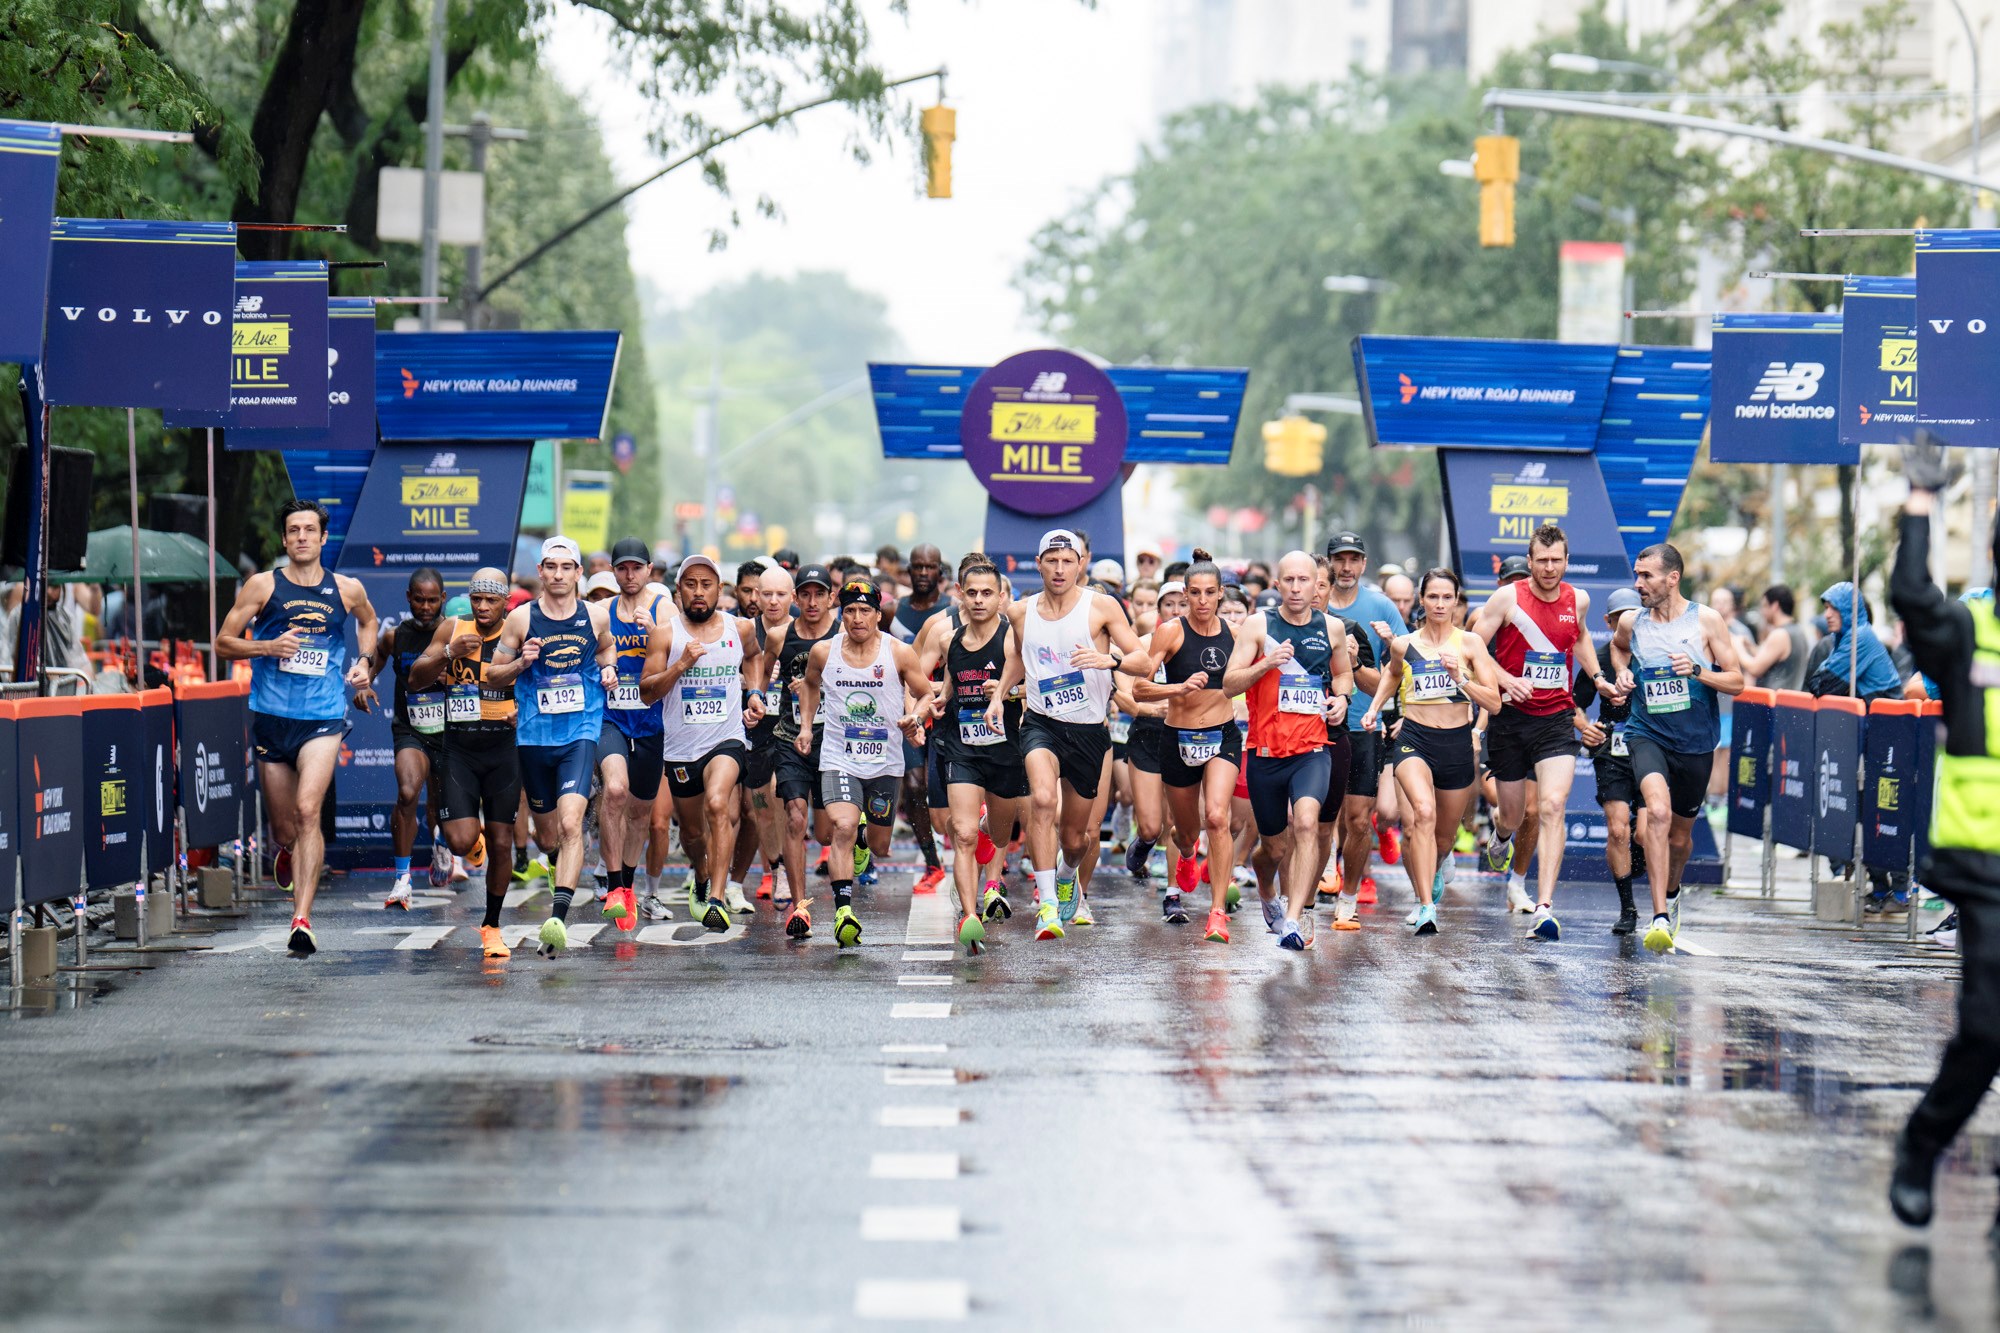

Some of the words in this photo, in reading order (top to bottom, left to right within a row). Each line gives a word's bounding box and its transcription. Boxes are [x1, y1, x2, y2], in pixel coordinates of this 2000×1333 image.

[60, 306, 222, 325] VOLVO
[236, 358, 279, 380] ILE
[423, 380, 452, 392] NEW
[453, 379, 486, 392] YORK
[487, 379, 521, 391] ROAD
[522, 379, 578, 391] RUNNERS
[239, 397, 261, 405] ROAD
[261, 397, 298, 405] RUNNERS
[1420, 386, 1450, 399] NEW
[1451, 387, 1484, 400] YORK
[1484, 388, 1519, 401] ROAD
[1519, 389, 1576, 403] RUNNERS
[1735, 404, 1768, 418] new
[1769, 402, 1836, 419] balance
[1873, 413, 1894, 422] NEW
[1893, 414, 1917, 422] YORK
[1003, 412, 1043, 433] 5th
[1002, 443, 1083, 473] MILE
[411, 483, 440, 500] 5th
[411, 507, 470, 528] MILE
[386, 553, 405, 562] NEW
[405, 553, 424, 562] YORK
[424, 553, 444, 562] ROAD
[445, 553, 479, 562] RUNNERS
[283, 600, 306, 610] DASHING
[306, 600, 334, 614] WHIPPETS
[1559, 614, 1576, 624] PPTC
[311, 626, 328, 634] TEAM
[562, 634, 588, 645] WHIPPETS
[295, 649, 323, 666] 3992
[545, 659, 568, 669] RUNNING
[568, 658, 581, 666] TEAM
[682, 665, 737, 678] EBELDES
[957, 669, 991, 682] URBAN
[1524, 666, 1532, 677] A
[1536, 666, 1561, 680] 2178
[678, 678, 714, 686] RUNNING
[835, 680, 884, 688] ORLANDO
[1414, 680, 1422, 692] A
[1425, 674, 1452, 689] 2102
[1647, 684, 1654, 697] A
[1656, 680, 1684, 696] 2168
[541, 693, 549, 706] A
[554, 689, 576, 704] 192
[609, 690, 617, 702] A
[620, 687, 639, 700] 210
[1045, 696, 1054, 708] A
[1055, 687, 1084, 705] 3958
[1281, 690, 1290, 701] A
[1293, 690, 1318, 704] 4092
[410, 707, 417, 719] A
[418, 705, 443, 719] 3478
[451, 699, 475, 713] 2913
[685, 704, 693, 716] A
[695, 700, 722, 715] 3292
[962, 726, 970, 739] A
[845, 742, 853, 754] A
[856, 742, 883, 755] 3609
[1614, 737, 1621, 747] A
[1181, 748, 1188, 759] A
